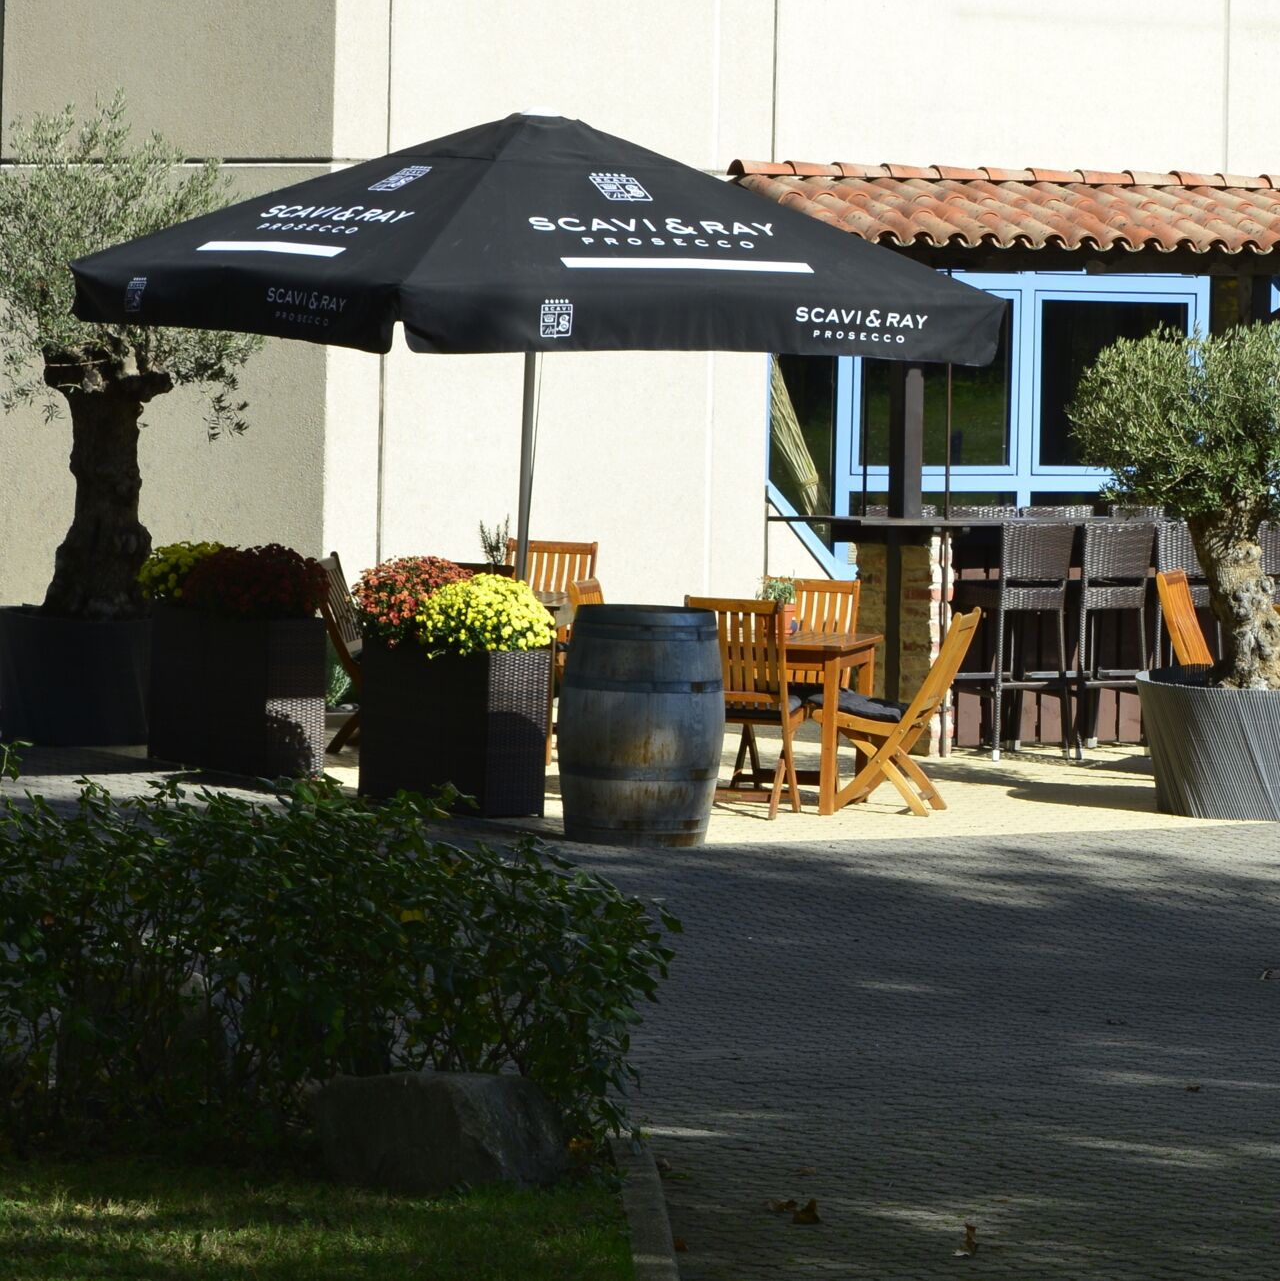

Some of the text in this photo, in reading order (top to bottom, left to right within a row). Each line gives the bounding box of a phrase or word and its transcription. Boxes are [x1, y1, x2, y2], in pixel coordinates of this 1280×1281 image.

[256, 222, 359, 235] PROSECCO
[581, 236, 755, 249] PROSECCO
[812, 329, 905, 344] PROSECCO
